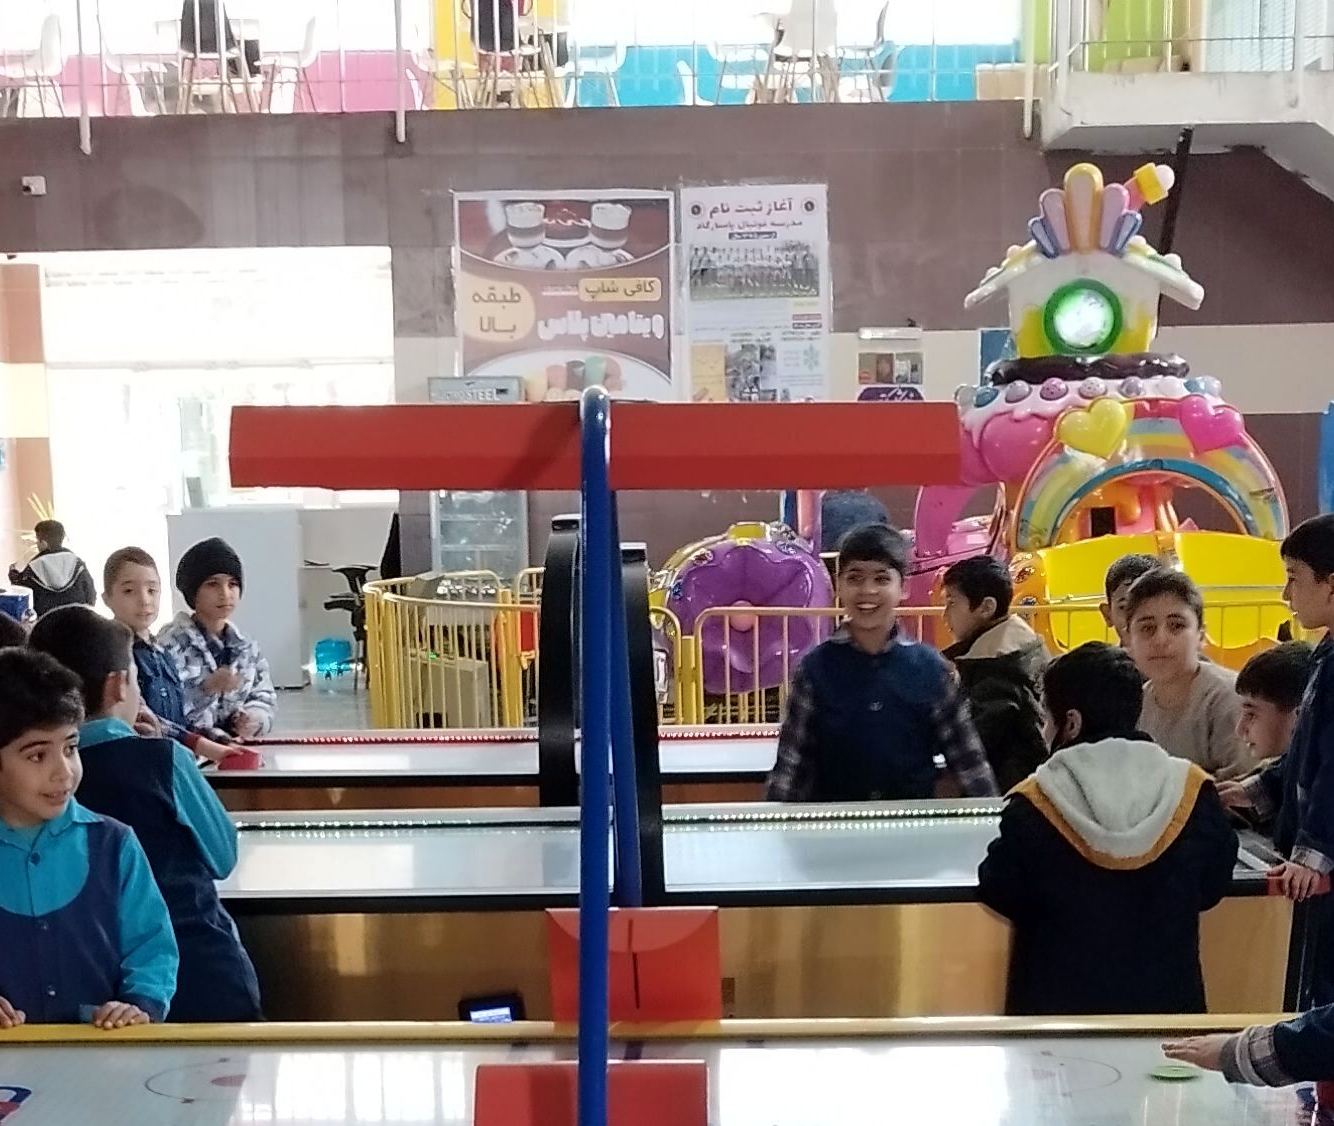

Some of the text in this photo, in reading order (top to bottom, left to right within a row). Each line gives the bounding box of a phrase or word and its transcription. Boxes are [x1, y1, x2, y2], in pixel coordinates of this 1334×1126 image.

[709, 197, 793, 219] آغاز ثبت نام
[471, 286, 522, 309] طبقه
[585, 280, 656, 299] کافی شاپ
[479, 315, 517, 339] بالا
[537, 310, 665, 342] ویتامین پلاس
